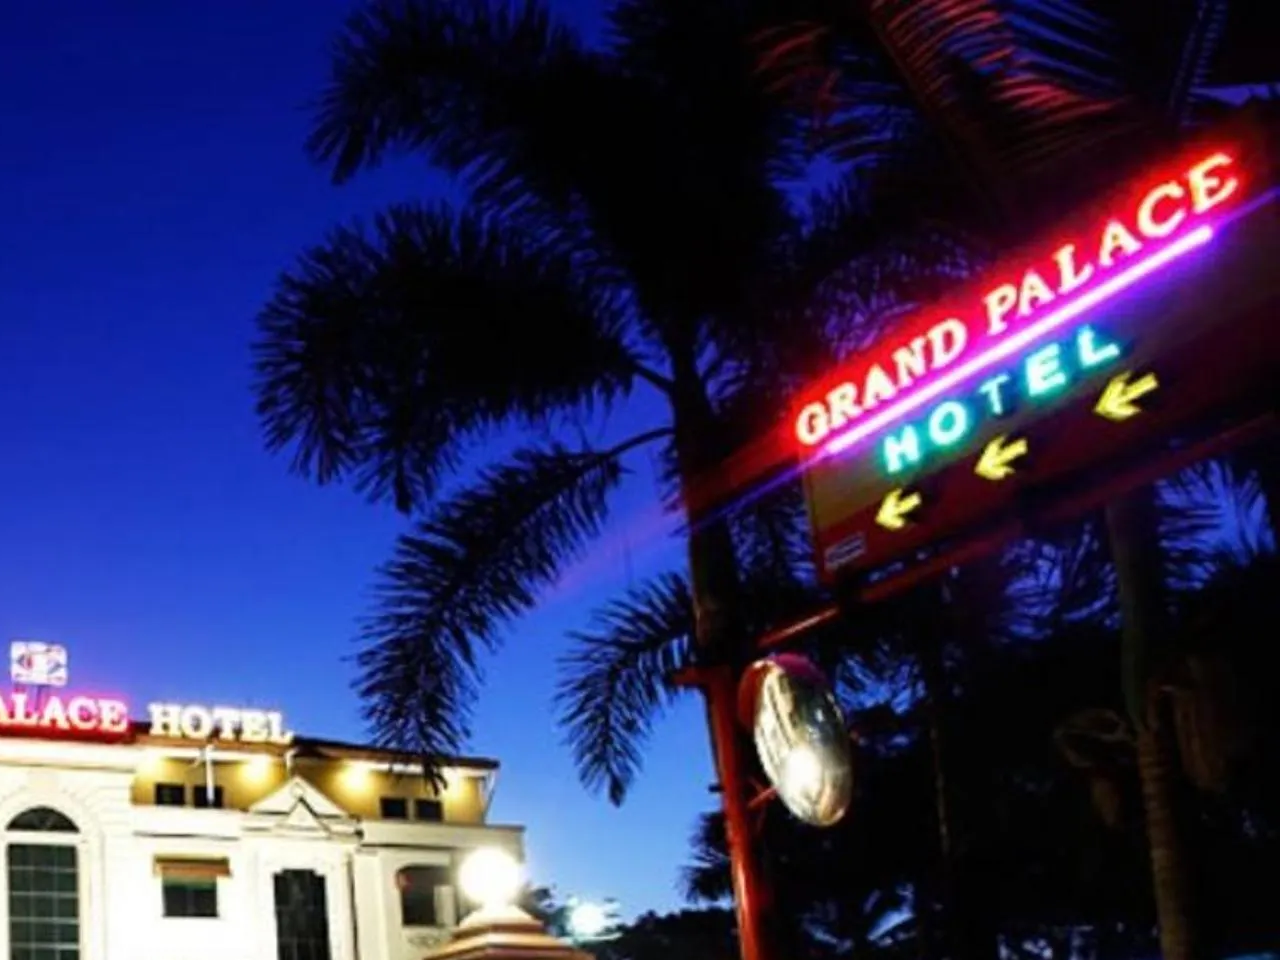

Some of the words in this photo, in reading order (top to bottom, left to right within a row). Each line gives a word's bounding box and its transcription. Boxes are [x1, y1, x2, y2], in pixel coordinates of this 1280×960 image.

[794, 316, 968, 446] GRAND
[984, 152, 1240, 336] PALACE
[880, 323, 1121, 474] HOTEL
[148, 702, 294, 744] HOTEL
